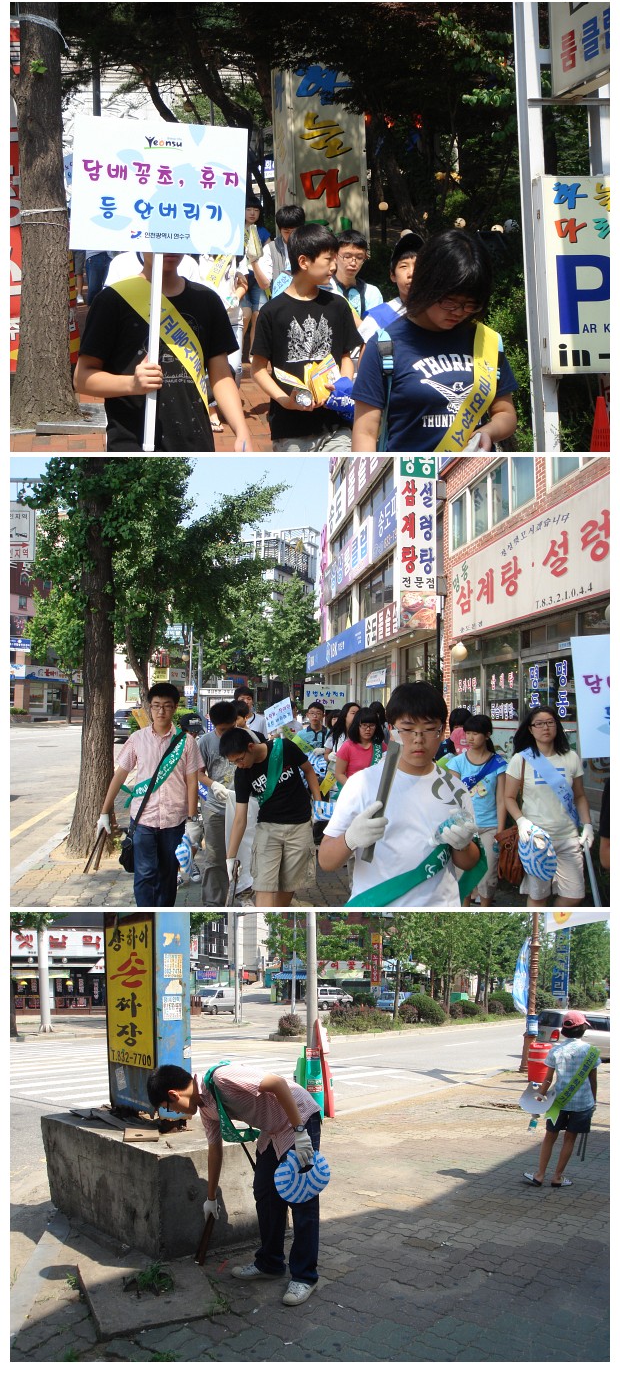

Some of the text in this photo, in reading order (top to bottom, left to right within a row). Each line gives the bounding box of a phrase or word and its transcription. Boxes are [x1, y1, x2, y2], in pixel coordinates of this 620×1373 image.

[144, 136, 183, 148] Yeonsu
[82, 159, 184, 187] 담배꽁초,
[200, 166, 239, 189] 휴지
[100, 196, 223, 221] 등 안버리기
[144, 231, 173, 240] 인천광역시
[412, 354, 474, 378] THORP
[401, 479, 417, 573] 삼계탕
[420, 482, 434, 575] 설렁탕
[402, 577, 435, 589] 전문점
[456, 556, 522, 615] 삼계탕
[555, 660, 569, 718] 명동
[111, 1050, 151, 1067] T.832-7700
